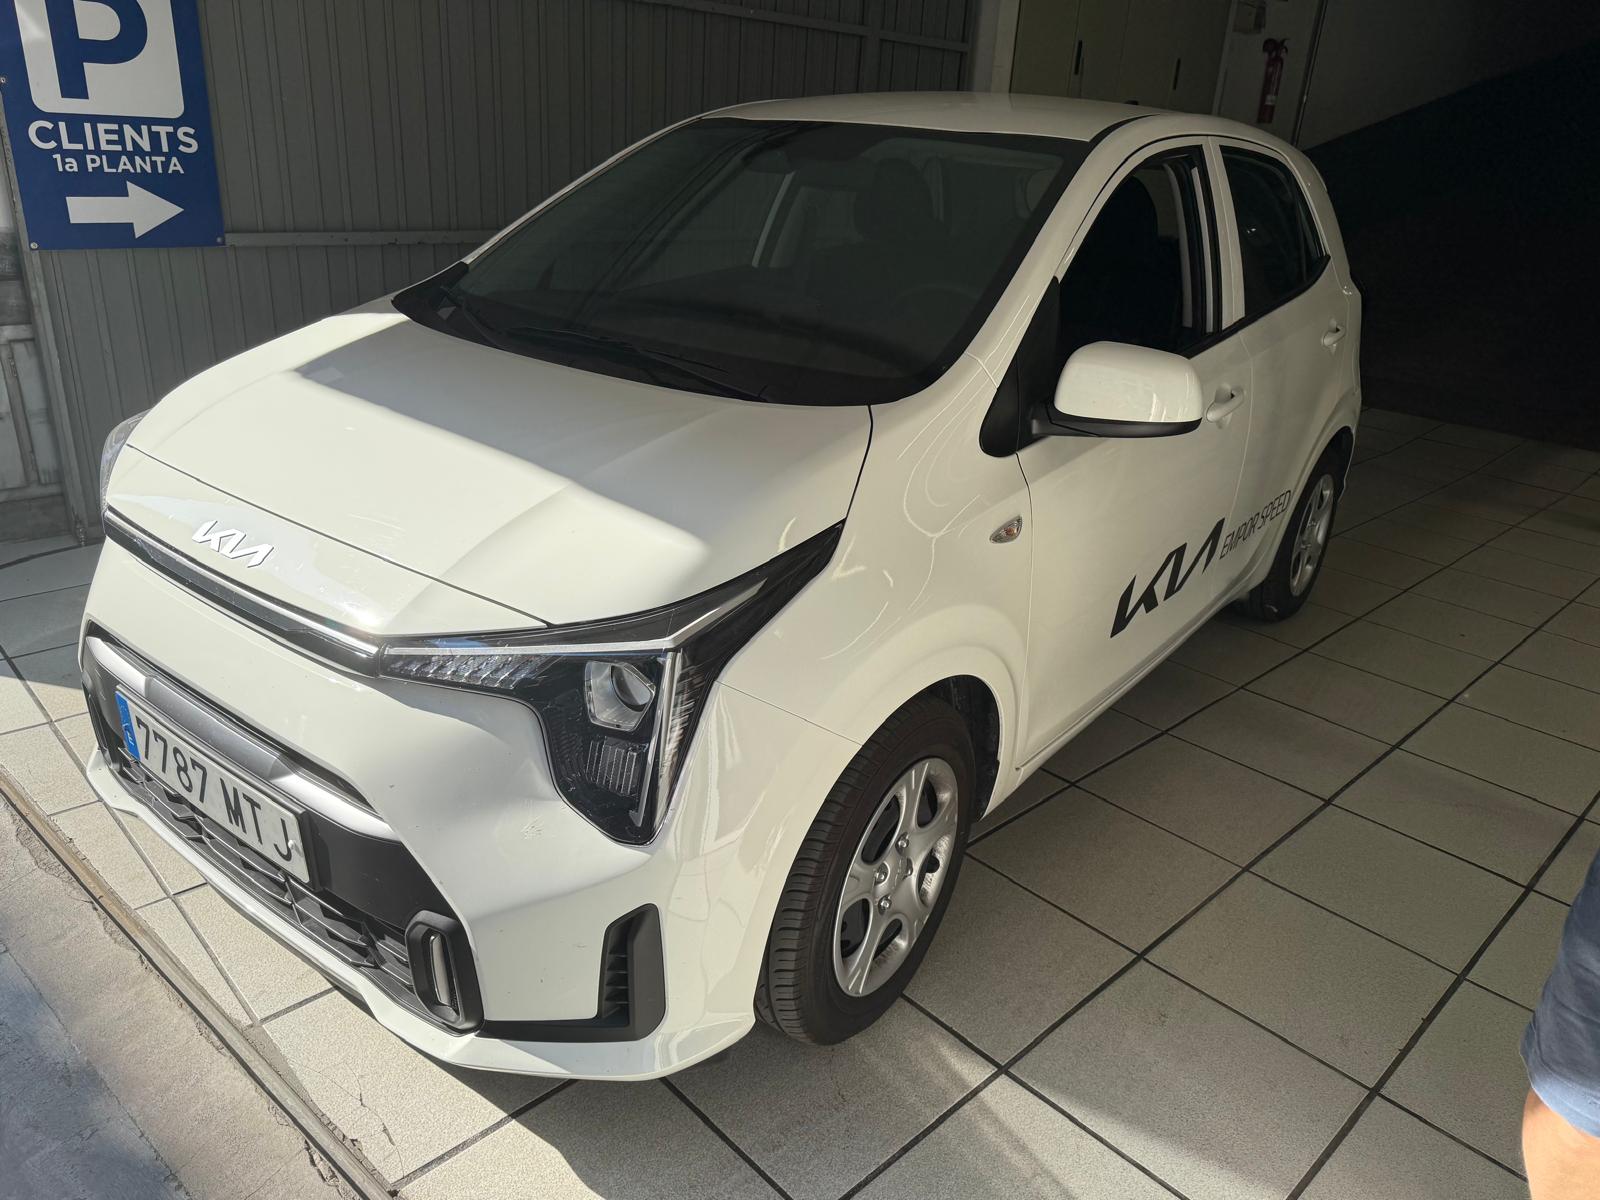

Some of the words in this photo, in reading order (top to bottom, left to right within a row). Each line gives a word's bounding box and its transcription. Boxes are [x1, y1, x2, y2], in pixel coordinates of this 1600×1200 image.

[44, 0, 149, 100] P
[27, 120, 199, 154] CLIENTS
[52, 153, 79, 172] 1a
[86, 154, 185, 174] PLANTA
[191, 520, 275, 569] KIA
[1109, 516, 1226, 639] KIA
[1218, 511, 1261, 560] EMPOR
[1257, 489, 1292, 530] SPEED
[135, 714, 208, 804] 7787
